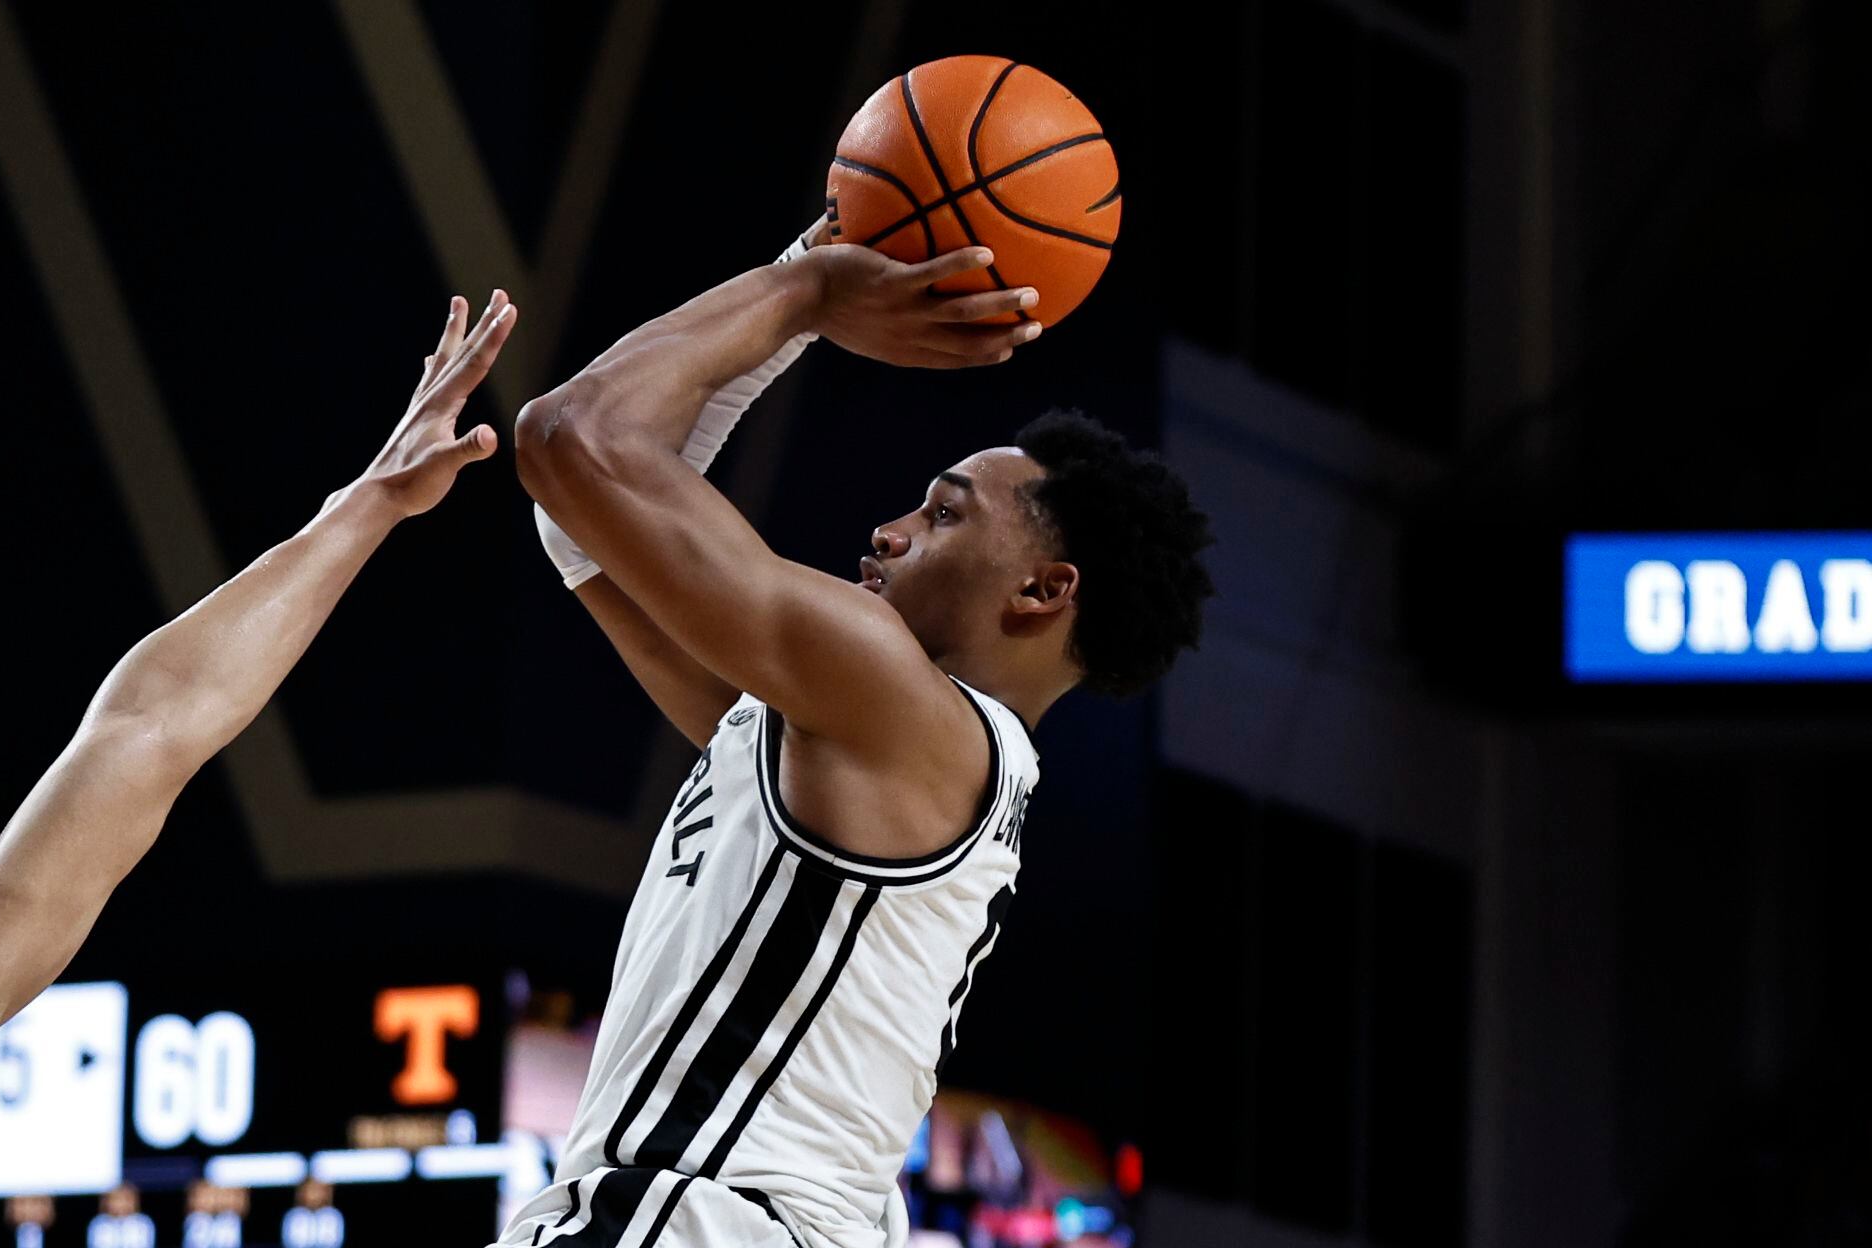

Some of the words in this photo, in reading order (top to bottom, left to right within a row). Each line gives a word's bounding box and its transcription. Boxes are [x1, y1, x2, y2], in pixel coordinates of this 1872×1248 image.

[1624, 558, 1872, 654] GRAD
[134, 1010, 256, 1149] 60
[374, 985, 481, 1106] T
